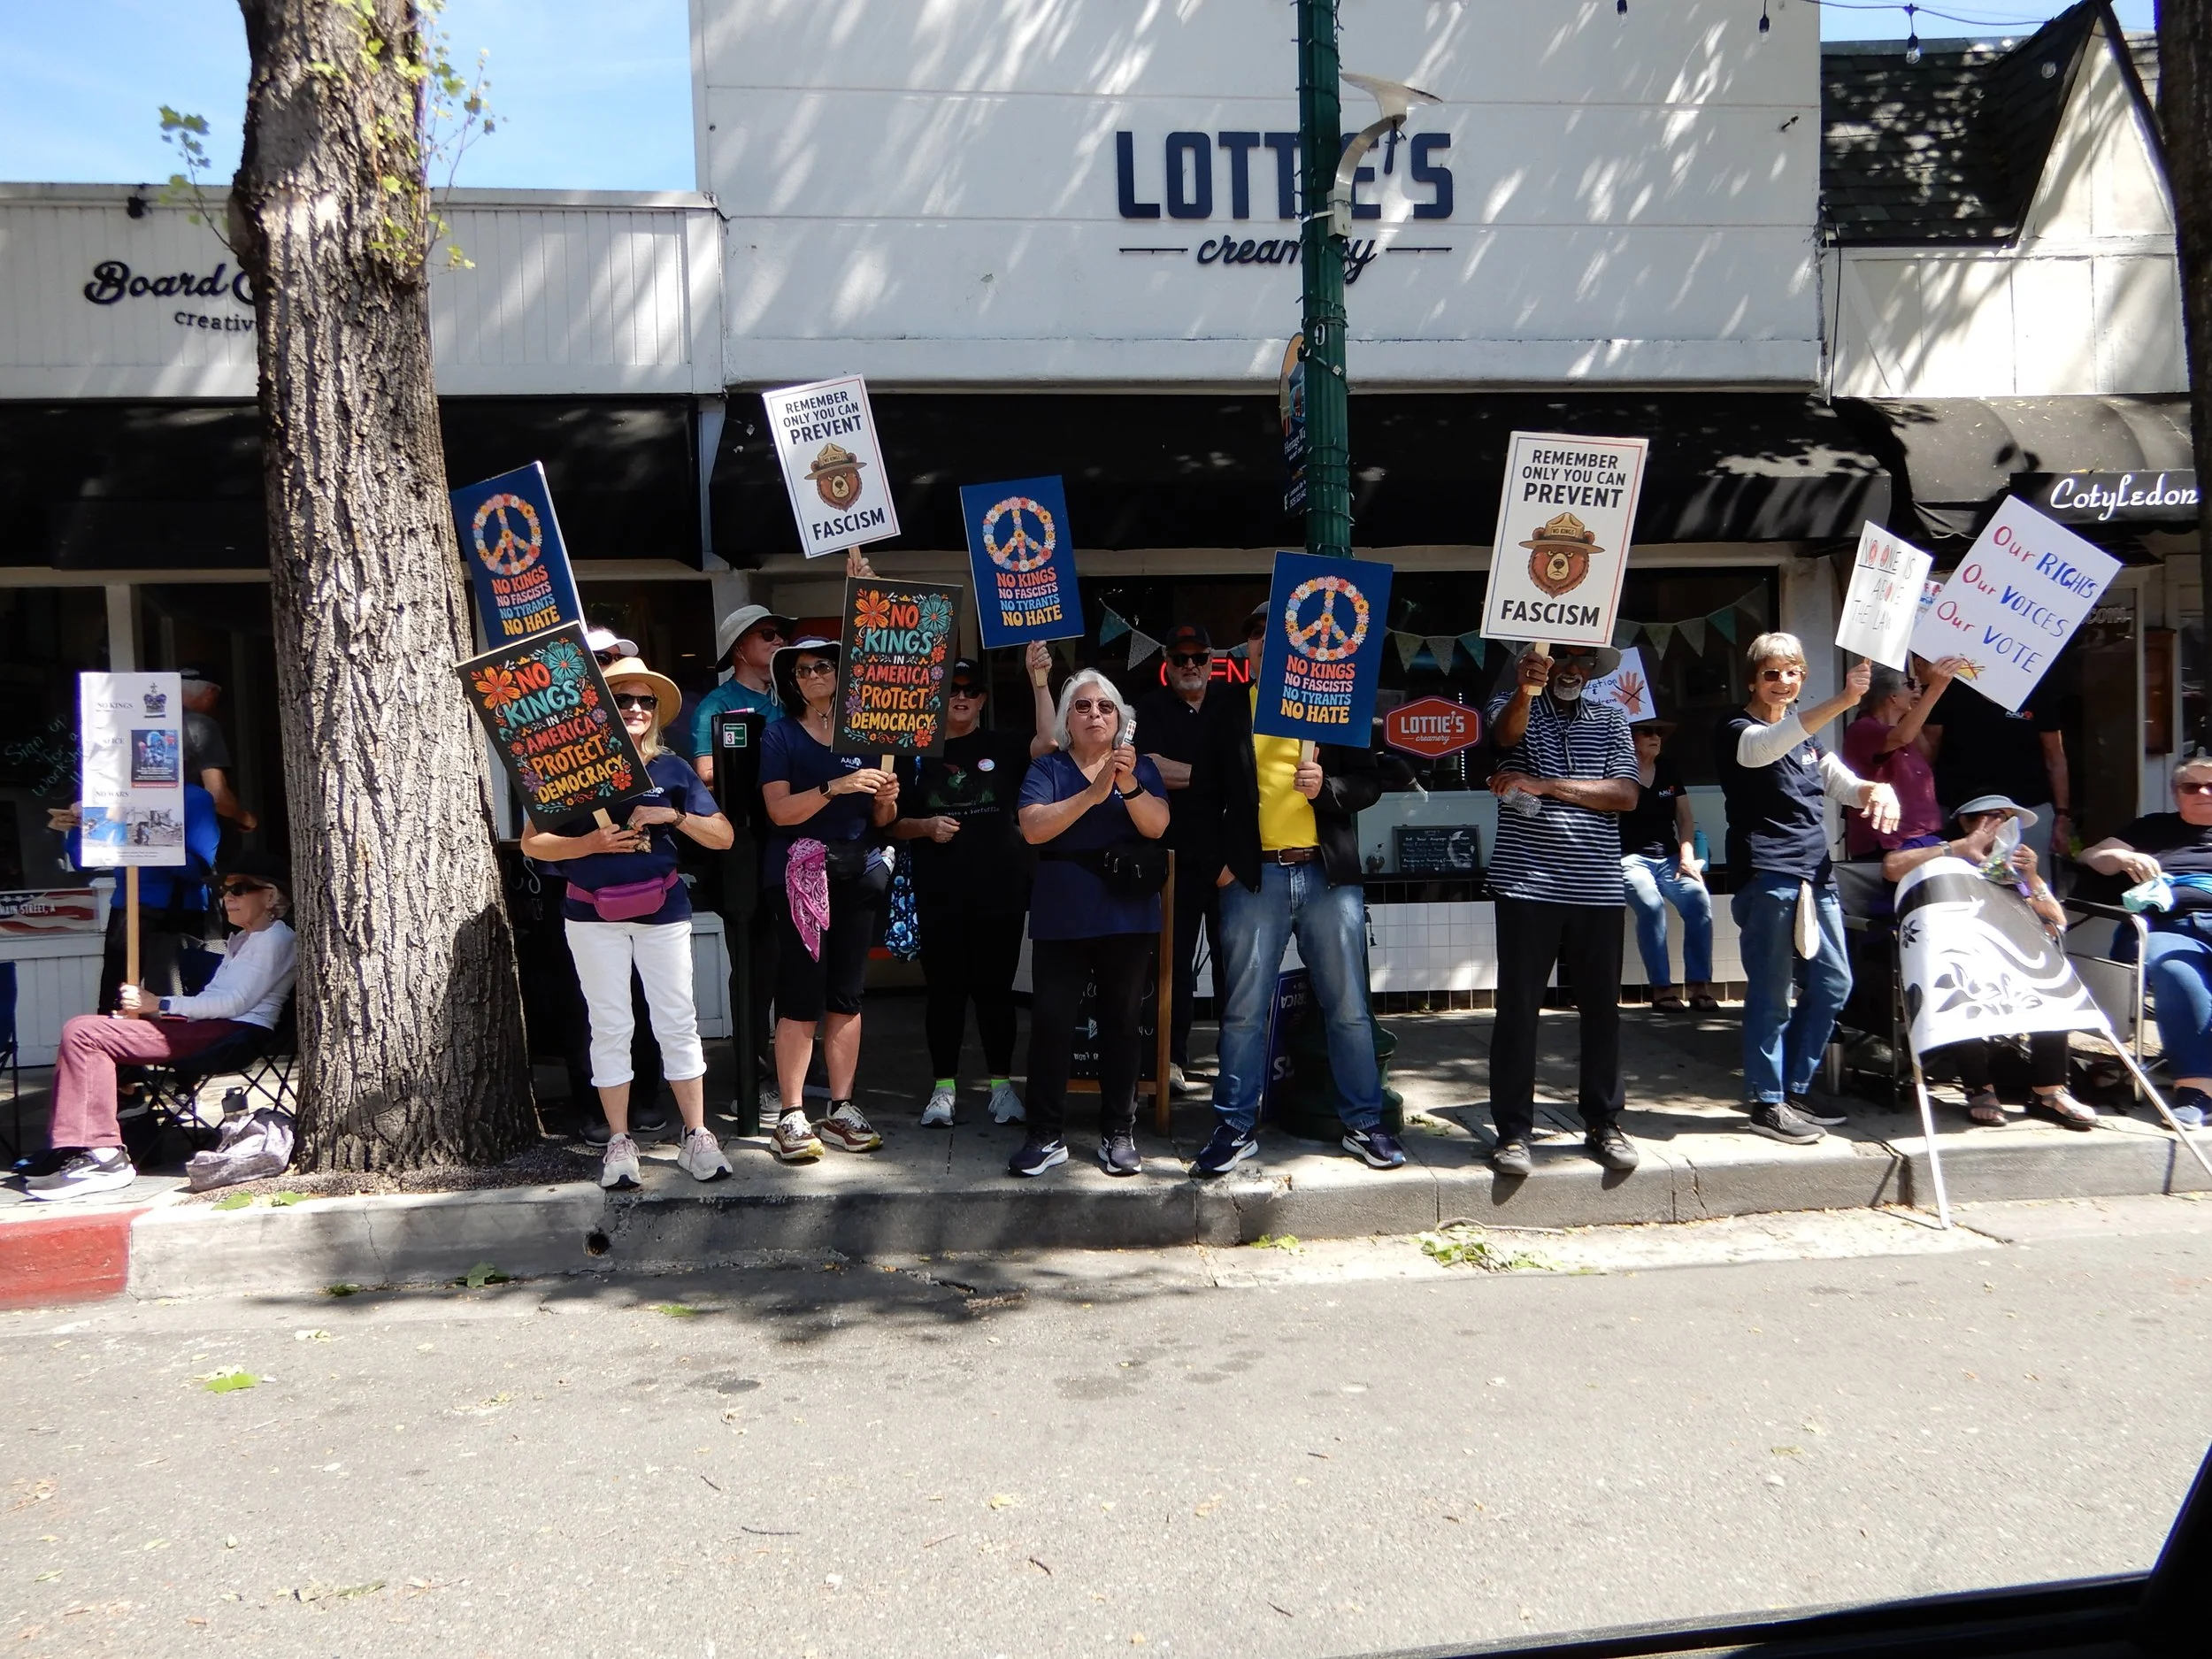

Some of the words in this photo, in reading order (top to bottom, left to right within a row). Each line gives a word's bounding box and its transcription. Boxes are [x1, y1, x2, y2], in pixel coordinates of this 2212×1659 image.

[1117, 131, 1454, 219] LOTTE'S
[84, 260, 228, 305] Board
[174, 311, 256, 332] creativ
[783, 413, 810, 427] ONLY
[813, 406, 835, 421] YOU
[838, 402, 859, 416] CAN
[785, 390, 849, 414] REMEMBER
[789, 415, 863, 445] PREVENT
[1532, 449, 1618, 469] REMEMBER
[1522, 465, 1559, 481] ONLY
[1564, 469, 1594, 483] YOU
[1596, 472, 1626, 486] CAN
[1523, 482, 1624, 509] PREVENT
[811, 507, 885, 541] FASCISM
[1860, 536, 1878, 566] NO
[1993, 525, 2036, 563] Our
[492, 578, 511, 595] NO
[511, 565, 549, 590] KINGS
[995, 572, 1017, 588] NO
[1018, 566, 1056, 588] KINGS
[495, 594, 511, 607] NO
[511, 581, 552, 603] FASCISTS
[998, 588, 1013, 600] NO
[1015, 582, 1059, 599] FASCISTS
[1000, 600, 1015, 611] NO
[1016, 594, 1060, 611] TYRANTS
[1962, 564, 1997, 596] Our
[1999, 585, 2070, 639] VOICES
[499, 606, 513, 619] NO
[513, 593, 556, 616] TYRANTS
[889, 604, 919, 629] NO
[1002, 611, 1024, 626] NO
[1025, 604, 1063, 626] HATE
[1501, 599, 1601, 627] FASCISM
[502, 618, 524, 636] NO
[525, 605, 561, 633] HATE
[864, 629, 933, 655] KINGS
[1936, 601, 1975, 633] Our
[1982, 625, 2044, 674] VOTE
[893, 655, 905, 664] IN
[1286, 654, 1308, 675] NO
[1310, 663, 1356, 680] KINGS
[514, 663, 551, 694] NO
[864, 664, 929, 685] AMERICA
[1284, 672, 1301, 686] NO
[1302, 677, 1354, 693] FASCISTS
[503, 680, 581, 728] KINGS
[861, 685, 929, 710] PROTECT
[1283, 685, 1299, 701] NO
[1301, 691, 1352, 706] TYRANTS
[546, 714, 559, 727] IN
[851, 711, 936, 733] DEMOCRACY
[1280, 698, 1303, 718] NO
[1306, 704, 1349, 724] HATE
[1401, 710, 1465, 733] LOTTIE'S
[525, 715, 599, 753] AMERICA
[727, 733, 733, 743] 3
[1415, 735, 1450, 745] creamery
[531, 733, 606, 780] PROTECT
[538, 754, 624, 804] DEMOCRACY
